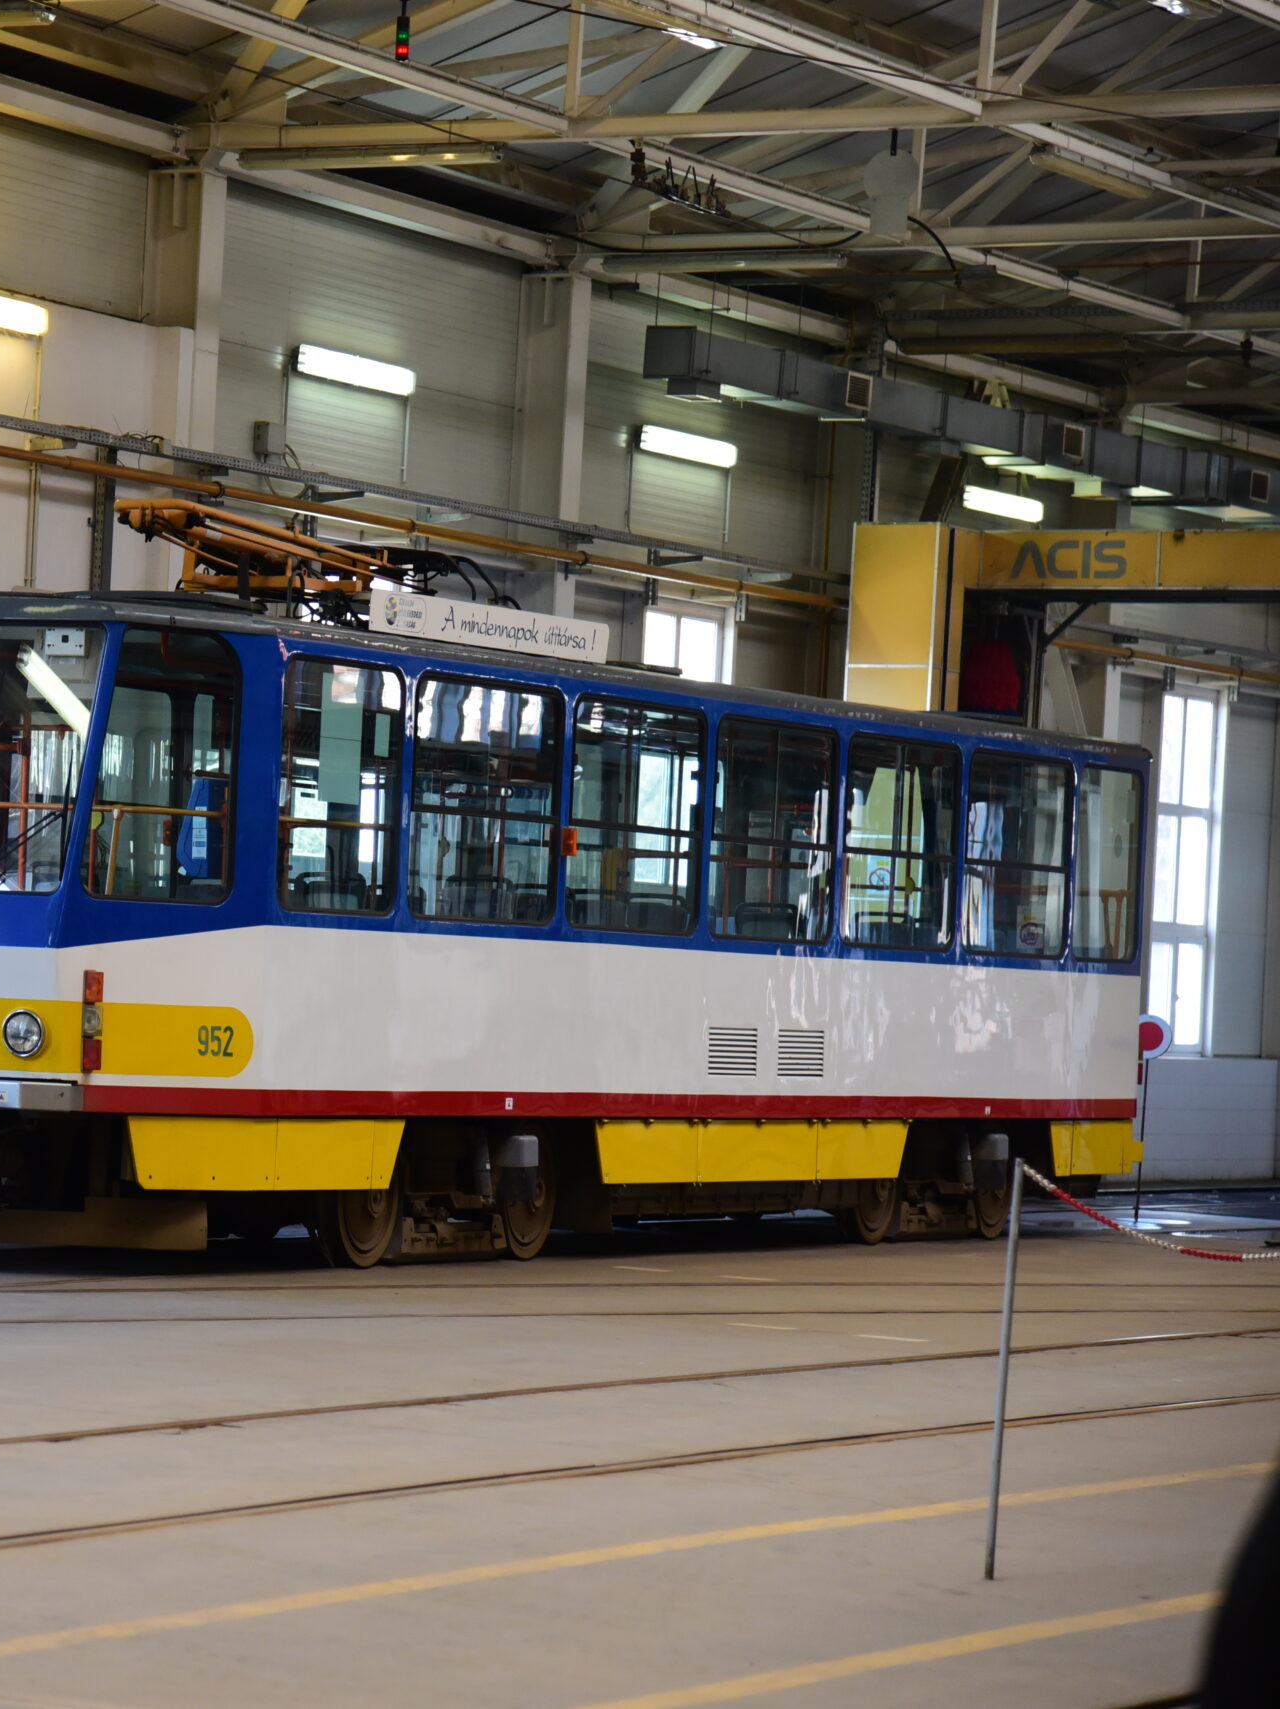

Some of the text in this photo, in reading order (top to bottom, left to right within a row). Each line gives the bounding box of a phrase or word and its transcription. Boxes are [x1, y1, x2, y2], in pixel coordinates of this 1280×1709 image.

[1010, 540, 1128, 579] ACIS
[441, 606, 456, 631] A
[460, 610, 539, 649] mindennapok
[197, 1025, 234, 1057] 952
